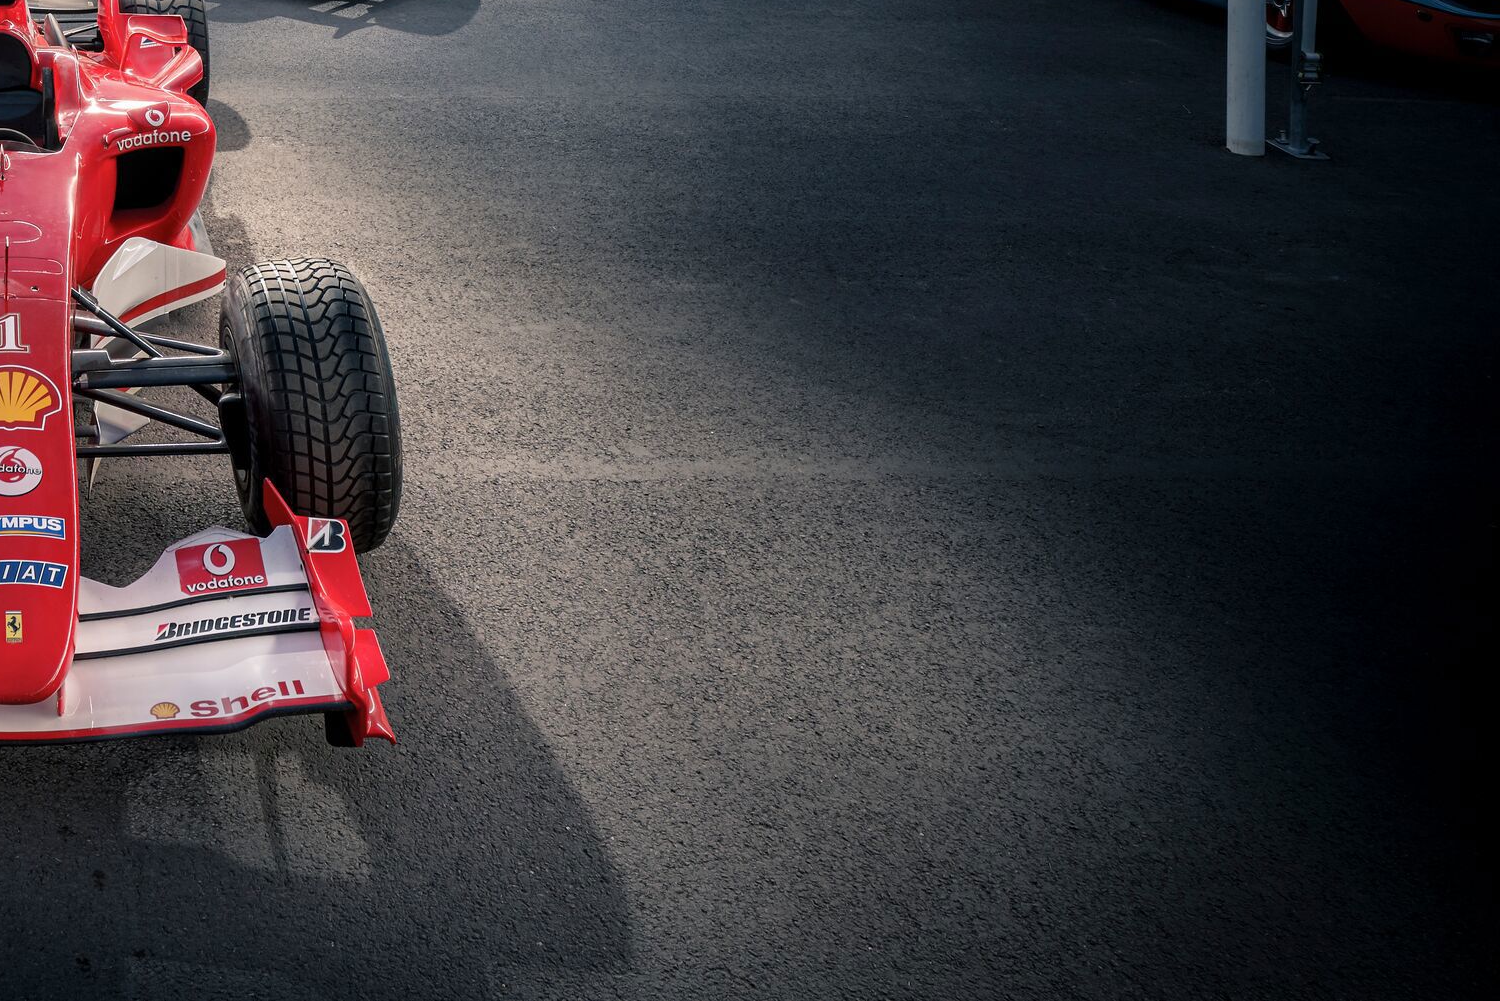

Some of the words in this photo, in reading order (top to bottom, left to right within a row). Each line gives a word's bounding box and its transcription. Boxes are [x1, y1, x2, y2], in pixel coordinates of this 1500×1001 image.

[117, 130, 191, 151] vodafone
[186, 574, 265, 593] vodafone
[155, 607, 311, 641] BRIDGESTONE
[190, 680, 305, 717] Shell
